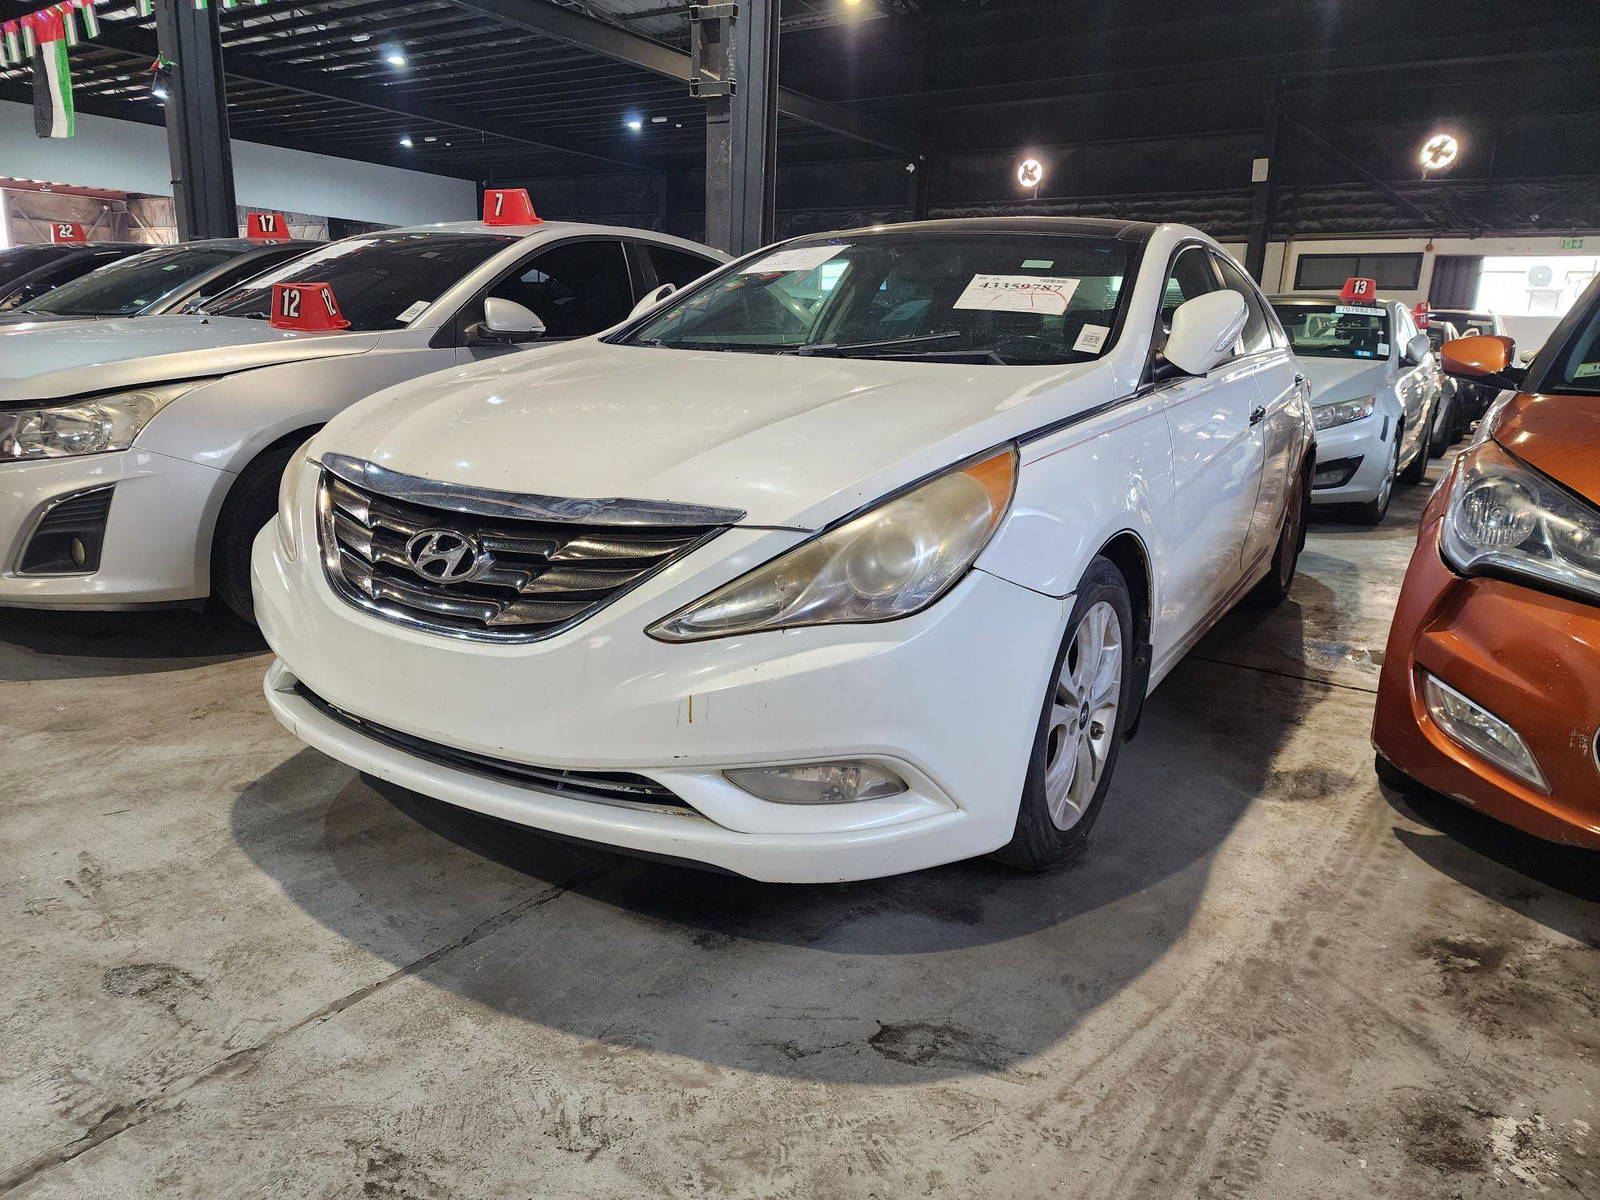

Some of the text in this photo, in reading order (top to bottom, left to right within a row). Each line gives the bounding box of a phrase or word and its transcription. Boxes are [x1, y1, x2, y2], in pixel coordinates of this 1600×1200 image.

[494, 193, 503, 216] 7
[59, 224, 74, 238] 22
[259, 215, 274, 232] 17
[1353, 280, 1368, 295] 13
[282, 288, 300, 318] 12
